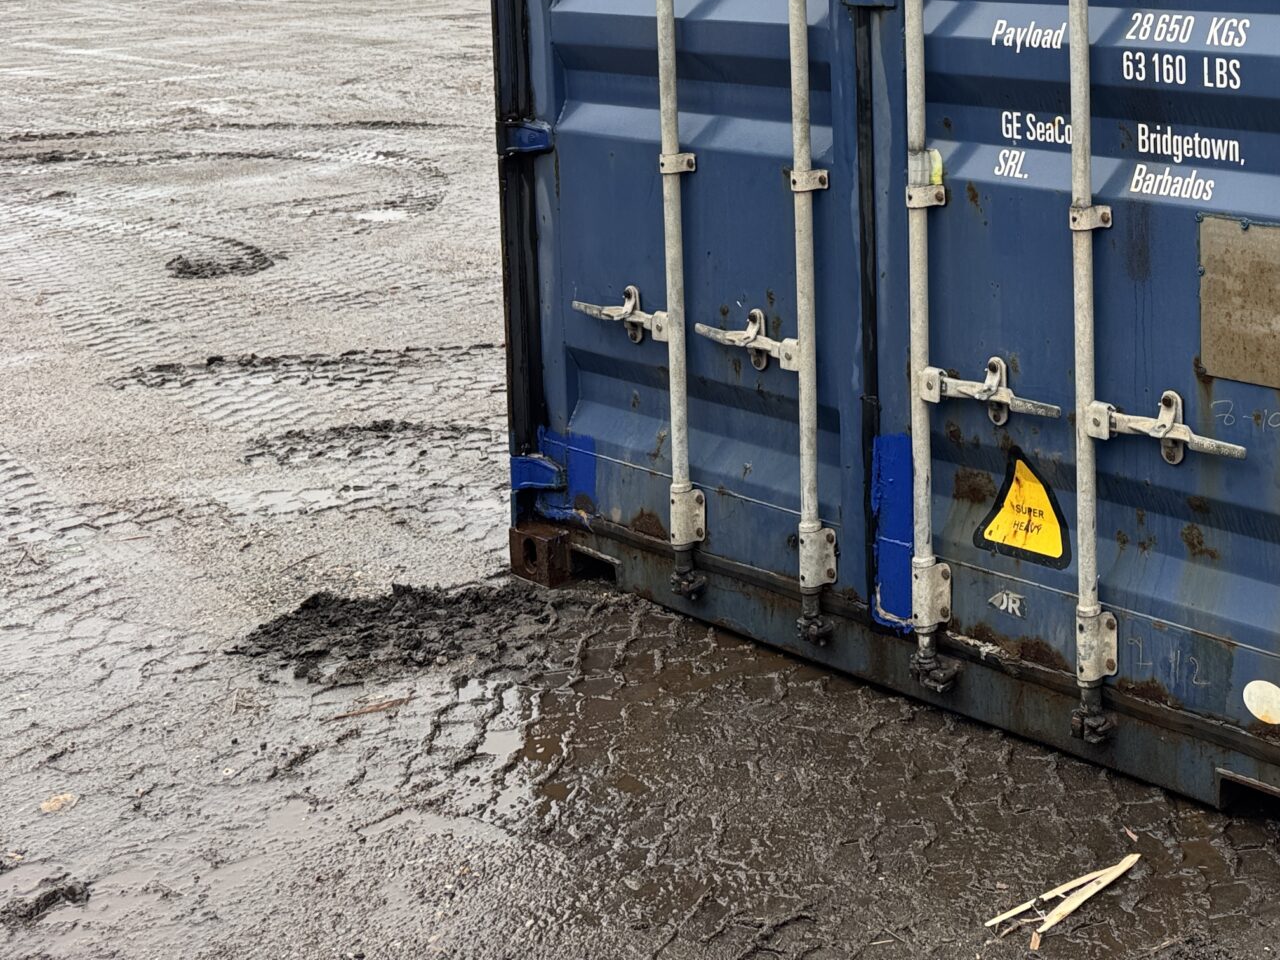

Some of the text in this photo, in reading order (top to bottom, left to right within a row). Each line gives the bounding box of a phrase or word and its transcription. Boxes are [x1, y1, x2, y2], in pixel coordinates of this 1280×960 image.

[991, 19, 1067, 53] Payload
[1206, 17, 1250, 48] KGS
[1203, 57, 1241, 90] LBS
[1002, 111, 1072, 145] GE SeaCo
[1137, 123, 1245, 165] Bridgetown,
[994, 149, 1029, 179] SRL.
[1130, 163, 1215, 201] Barbados
[1013, 520, 1043, 535] HEAVY
[1015, 504, 1044, 519] SUPER
